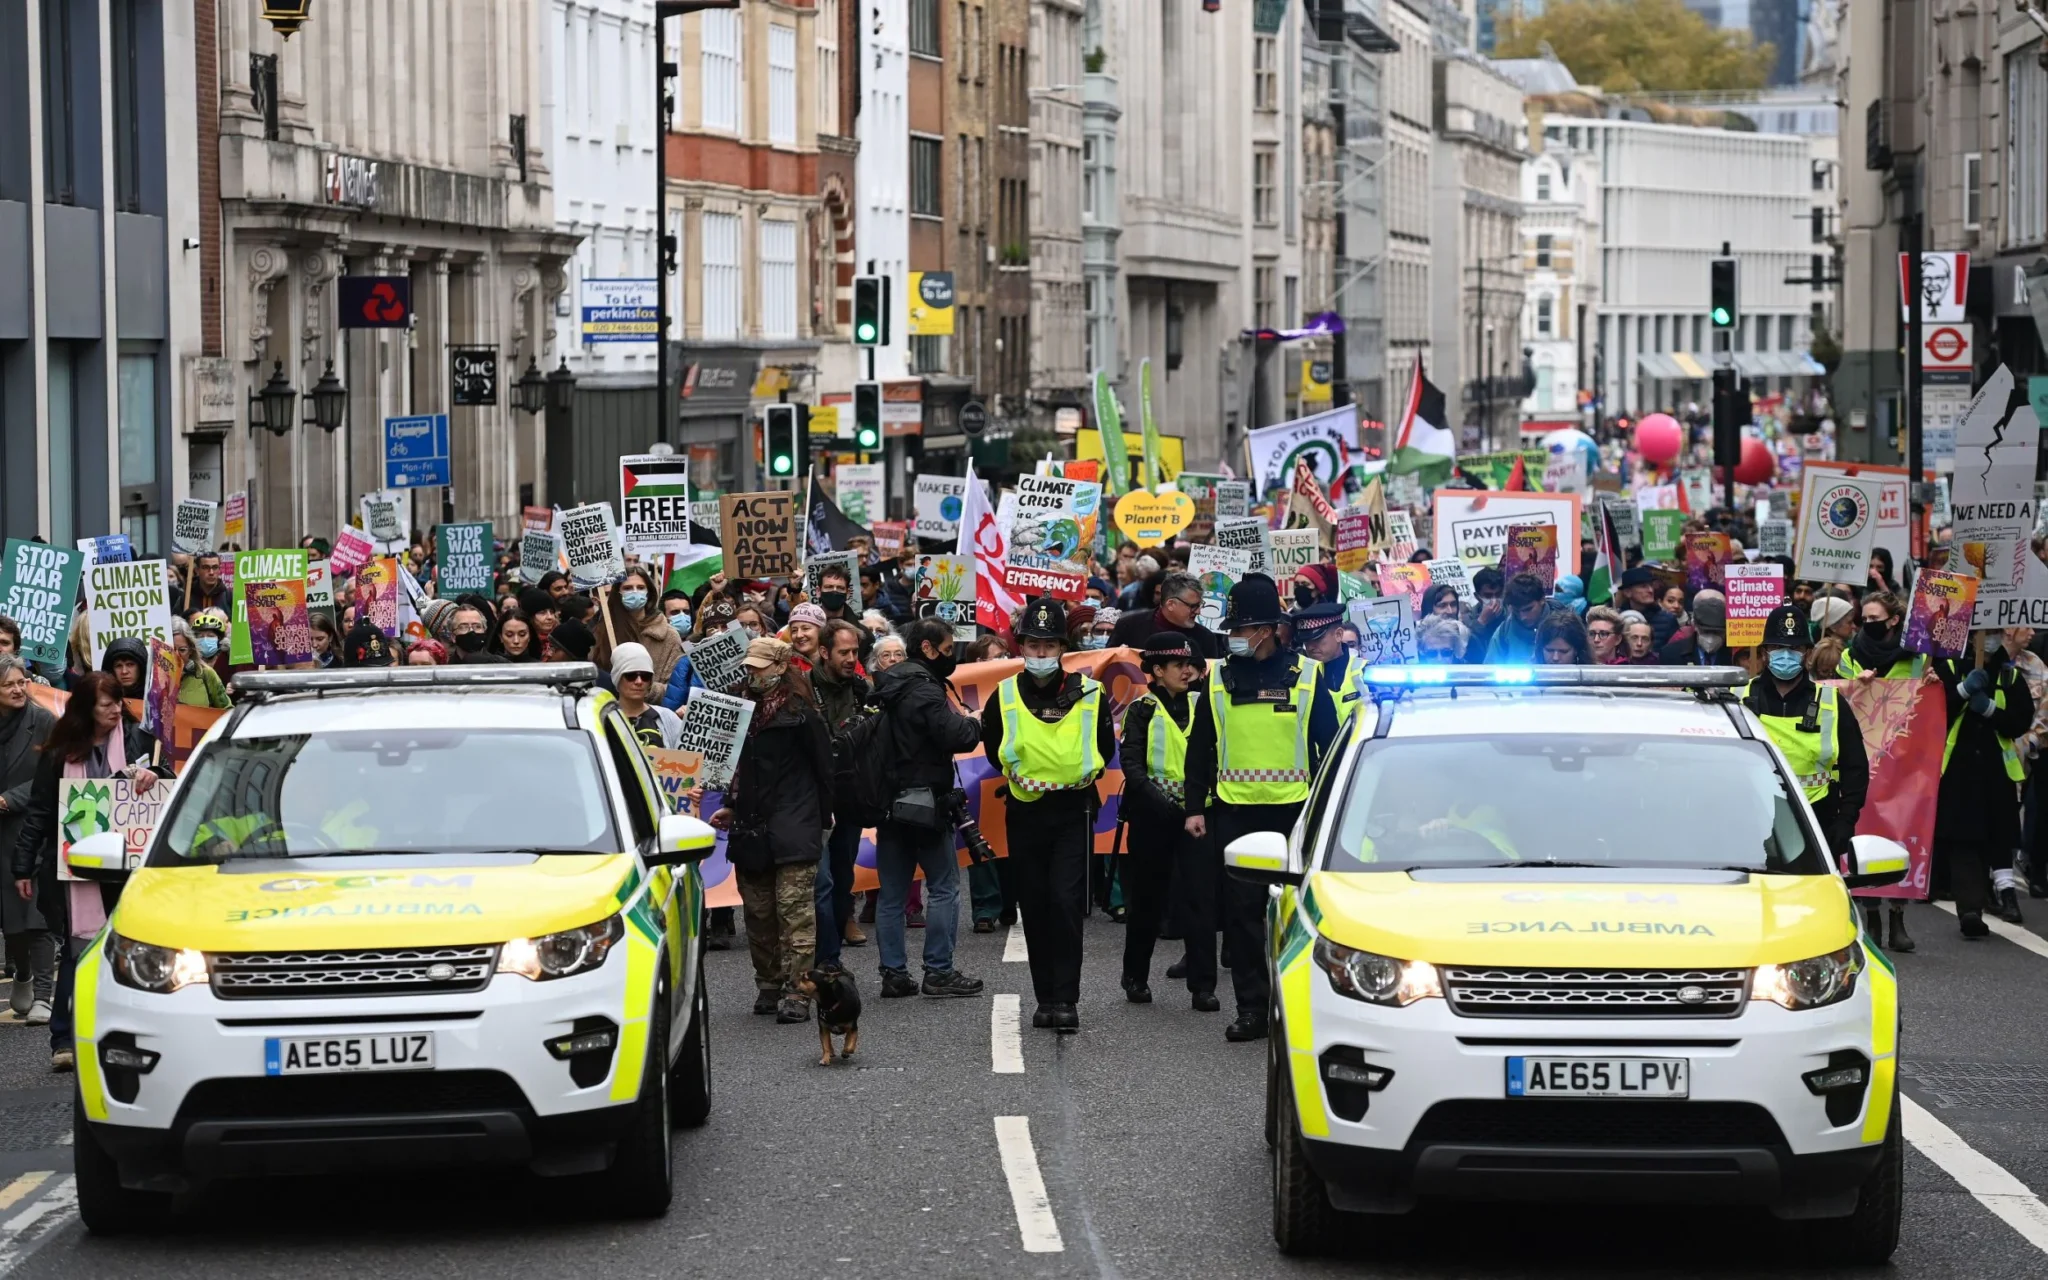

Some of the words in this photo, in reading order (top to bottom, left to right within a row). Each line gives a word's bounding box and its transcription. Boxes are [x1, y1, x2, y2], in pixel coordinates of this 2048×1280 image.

[605, 294, 620, 304] To
[624, 294, 642, 304] Let
[591, 306, 657, 321] perkinsfox
[455, 356, 493, 376] One
[1290, 426, 1317, 440] THE
[918, 483, 950, 495] MAKE
[1020, 478, 1075, 496] CLIMATE
[732, 497, 789, 518] ACT
[1018, 494, 1064, 509] CRISIS
[1820, 500, 1831, 526] SAVE
[1830, 487, 1851, 499] OUR
[1852, 491, 1867, 529] PLANET
[178, 505, 209, 514] SYSTEM
[178, 512, 210, 522] CHANGE
[565, 509, 584, 518] Socialist
[584, 505, 602, 514] Worker
[625, 497, 687, 522] FREE
[691, 504, 720, 516] CLIMA
[1016, 510, 1024, 519] is
[1956, 505, 1975, 520] WE
[1977, 502, 2016, 519] NEED
[2019, 502, 2031, 518] A
[177, 518, 192, 526] NOT
[561, 513, 603, 531] SYSTEM
[737, 517, 788, 536] NOW
[916, 520, 947, 531] COOL
[1124, 514, 1167, 524] Planet
[1171, 514, 1180, 524] B
[1338, 519, 1362, 530] Climate
[176, 525, 209, 535] CLIMATE
[446, 526, 484, 540] STOP
[563, 522, 608, 540] CHANGE
[626, 521, 687, 534] PALESTINE
[1217, 526, 1258, 540] SYSTEM
[1338, 529, 1367, 541] refugees
[175, 531, 208, 540] CHANGE
[566, 536, 586, 550] NOT
[1219, 534, 1262, 548] CHANGE
[1274, 536, 1286, 545] BE
[1290, 535, 1311, 544] LESS
[448, 539, 482, 553] WAR
[568, 540, 613, 558] CLIMATE
[734, 536, 787, 555] ACT
[1337, 539, 1366, 551] welcome
[15, 544, 70, 571] STOP
[92, 552, 129, 565] CLIMATE
[447, 553, 484, 568] STOP
[570, 550, 613, 567] CHANGE
[1009, 553, 1051, 569] HEALTH
[1810, 547, 1861, 560] SHARING
[239, 554, 303, 579] CLIMATE
[737, 552, 794, 578] FAIR
[2011, 538, 2027, 586] NUKES
[15, 563, 63, 590] WAR
[92, 563, 162, 591] CLIMATE
[440, 565, 491, 579] CLIMATE
[1428, 565, 1461, 575] SYSTEM
[1430, 571, 1465, 581] CHANGE
[445, 576, 487, 589] CHAOS
[1005, 570, 1081, 592] EMERGENCY
[1728, 579, 1774, 592] Climate
[7, 584, 61, 611] STOP
[94, 589, 163, 610] ACTION
[1728, 592, 1781, 607] refugees
[0, 602, 67, 630] CLIMATE
[110, 609, 149, 629] NOT
[1729, 605, 1773, 618] welcom
[1983, 609, 1993, 617] OF
[1998, 599, 2048, 625] PEACE
[1728, 622, 1744, 630] Fight
[690, 635, 736, 662] SYSTEM
[695, 643, 744, 672] CHANGE
[700, 665, 723, 681] NOT
[706, 665, 747, 691] CLIMAT
[700, 692, 725, 704] Socialist
[724, 699, 743, 707] Worker
[689, 700, 739, 721] SYSTEM
[687, 711, 739, 732] CHANGE
[683, 722, 710, 737] NOT
[680, 733, 733, 754] CLIMATE
[114, 802, 164, 826] CAPIT
[286, 1039, 362, 1069] AE65
[371, 1035, 428, 1065] LUZ
[1529, 1062, 1611, 1091] AE65
[1620, 1062, 1680, 1091] LPV
